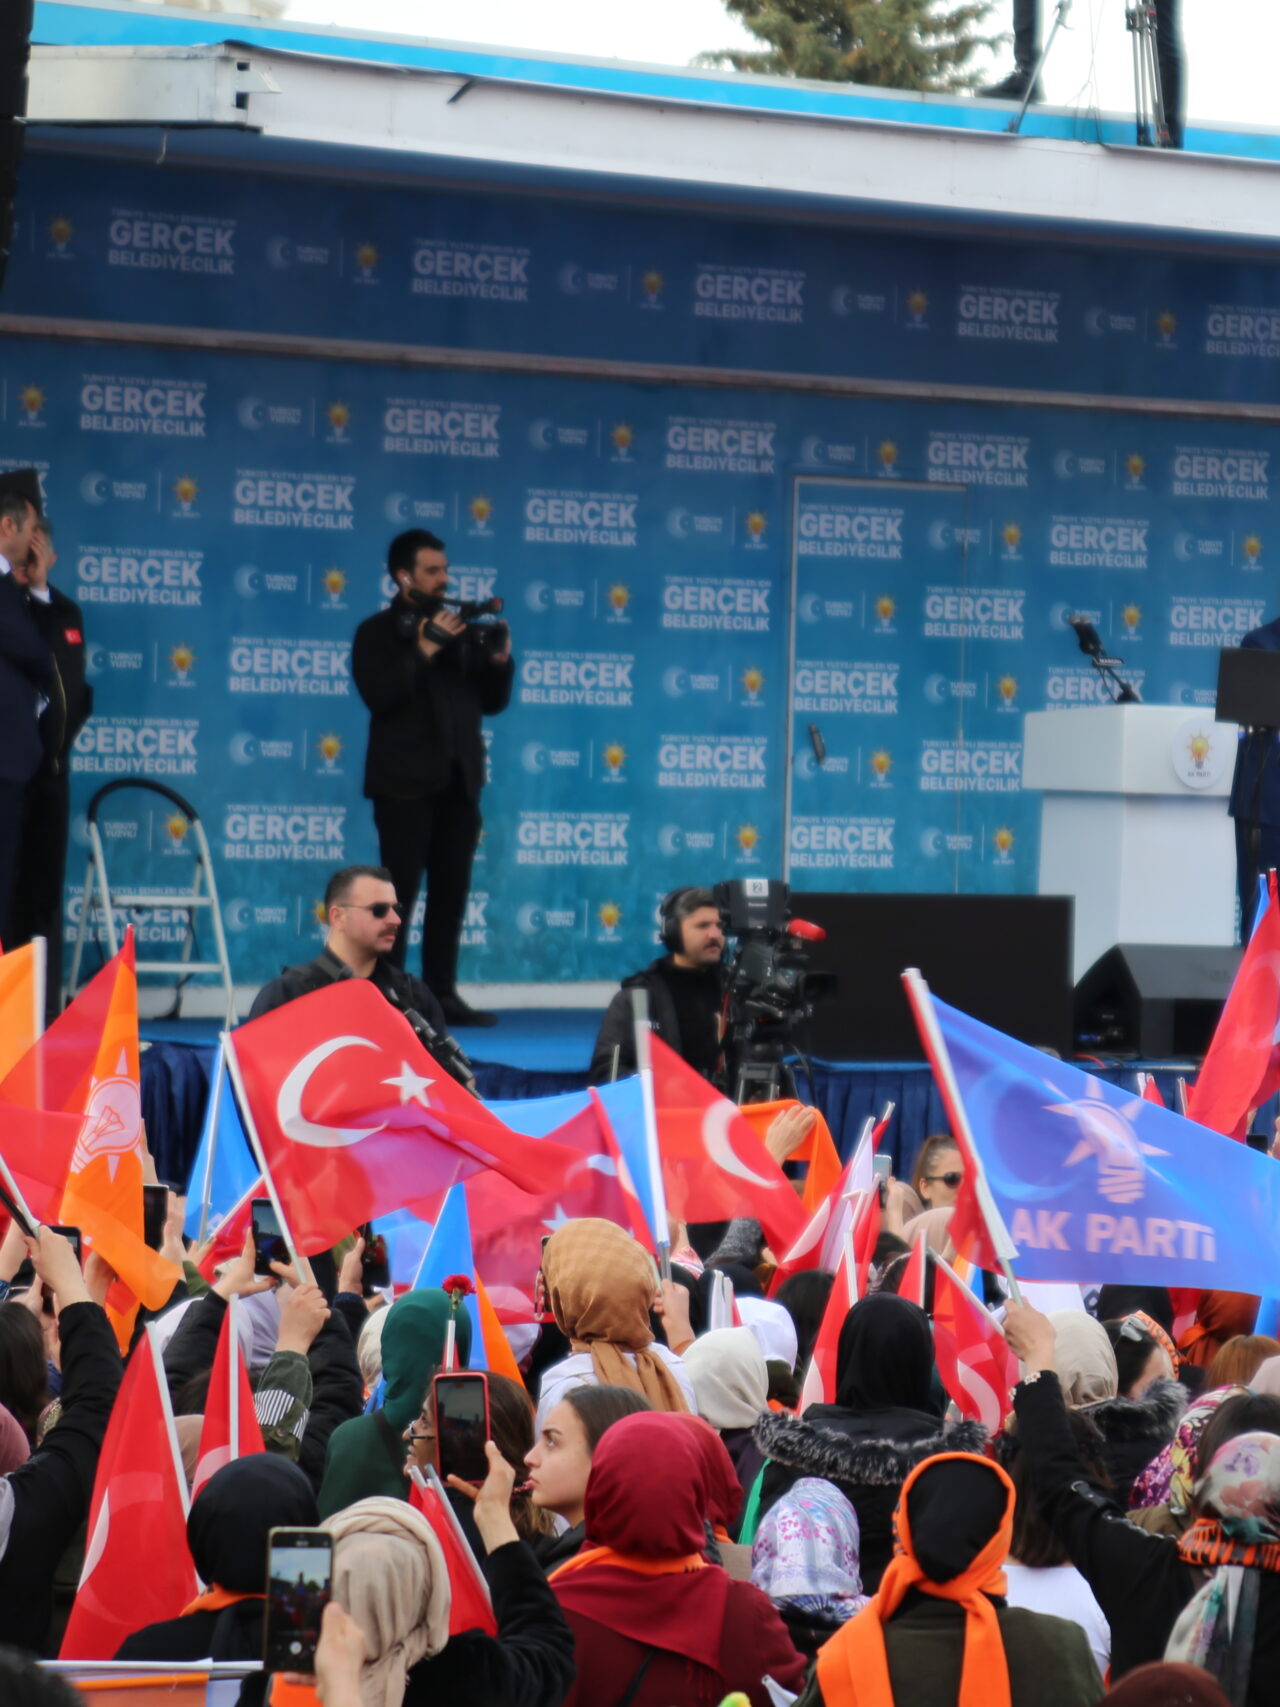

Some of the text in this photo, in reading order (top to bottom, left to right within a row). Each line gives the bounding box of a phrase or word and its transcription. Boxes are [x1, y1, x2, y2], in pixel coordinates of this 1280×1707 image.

[110, 219, 236, 255] GERÇEK
[414, 249, 529, 283] GERÇEK
[696, 273, 805, 305] GERÇEK
[960, 294, 1058, 326] GERÇEK
[82, 384, 205, 417] GERÇEK
[384, 407, 500, 439] GERÇEK
[667, 425, 775, 456] GERÇEK
[928, 440, 1028, 470] GERÇEK
[1174, 455, 1268, 483] GERÇEK
[235, 479, 354, 511] GERÇEK
[526, 498, 637, 528] GERÇEK
[799, 512, 903, 542] GERÇEK
[1050, 524, 1148, 552] GERÇEK
[78, 556, 202, 588] GERÇEK
[662, 585, 770, 615] GERÇEK
[924, 595, 1025, 623] GERÇEK
[1170, 605, 1264, 632] GERÇEK
[230, 647, 350, 678] GERÇEK
[521, 660, 633, 689] GERÇEK
[794, 669, 898, 697] GERÇEK
[73, 727, 197, 757] GERÇEK
[659, 744, 766, 772] GERÇEK
[920, 749, 1021, 776] GERÇEK
[225, 814, 345, 843] GERÇEK
[517, 821, 629, 849] GERÇEK
[790, 825, 894, 852] GERÇEK
[752, 883, 763, 893] 2
[1011, 1208, 1216, 1262] AK PARTİ
